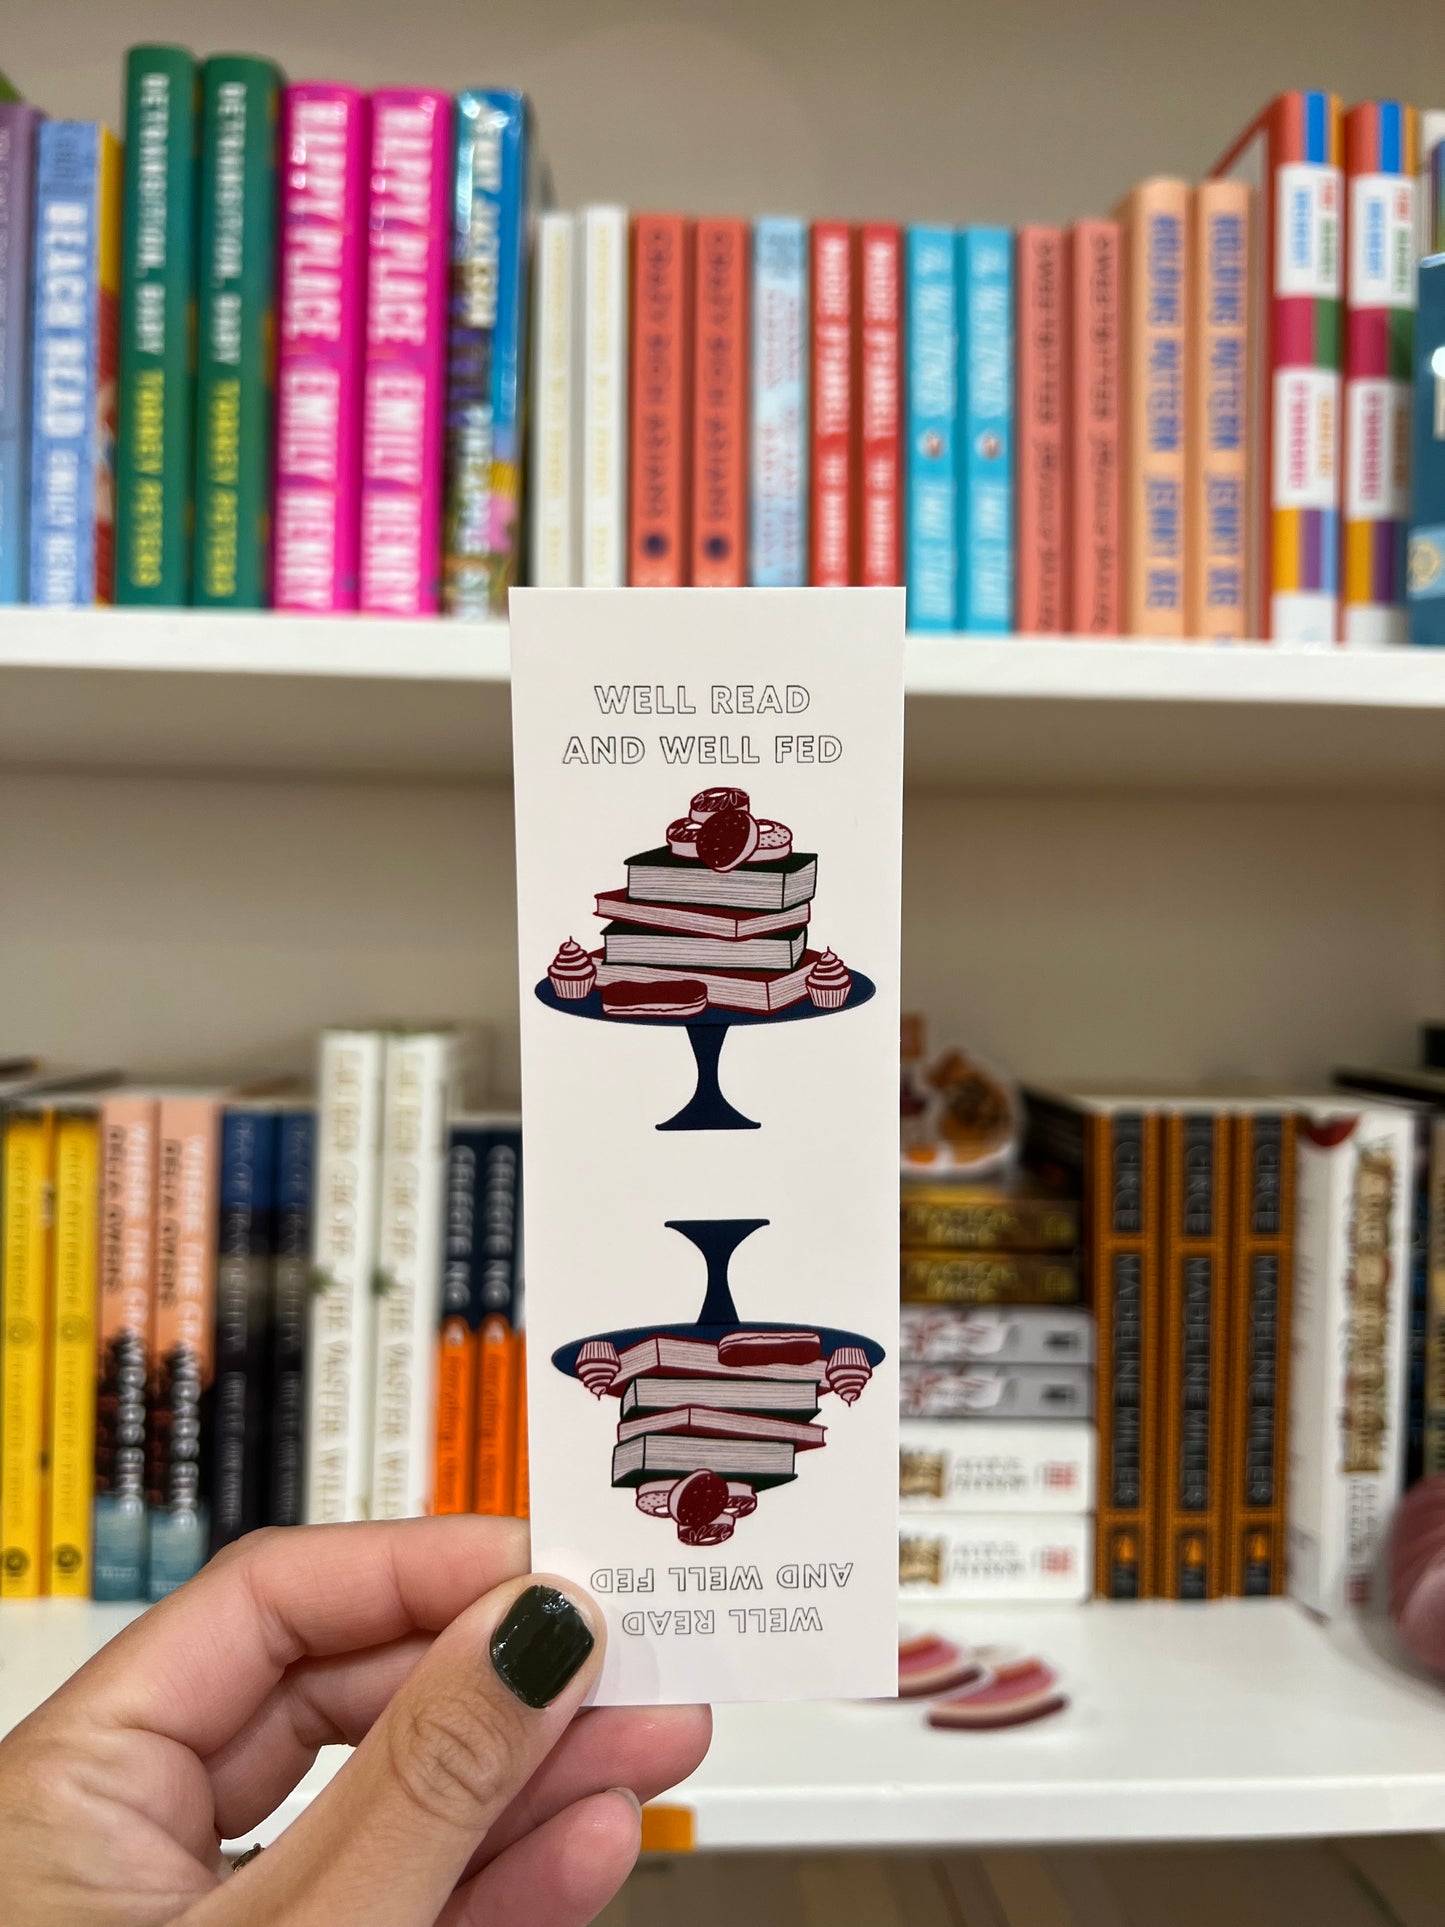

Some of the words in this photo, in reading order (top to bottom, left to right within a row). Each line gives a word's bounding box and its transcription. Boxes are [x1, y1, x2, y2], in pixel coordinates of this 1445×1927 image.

[287, 99, 348, 221] HAPPY
[371, 102, 434, 225] HAPPY
[44, 202, 87, 329] BEACH
[284, 223, 343, 342] PLACE
[367, 227, 429, 347] PLACE
[41, 336, 87, 438] READ
[280, 366, 339, 480] EMILY
[366, 368, 425, 484] EMILY
[278, 491, 337, 609] HENRY
[362, 499, 422, 610] HENRY
[562, 736, 645, 764] AND
[660, 736, 760, 764] WELL
[775, 735, 843, 763] FED
[594, 685, 696, 714] WELL
[711, 685, 810, 714] READ
[590, 1568, 654, 1593] FED
[622, 1610, 715, 1636] READ
[668, 1566, 763, 1592] WELL
[729, 1607, 823, 1633] WELL
[776, 1563, 854, 1589] AND
